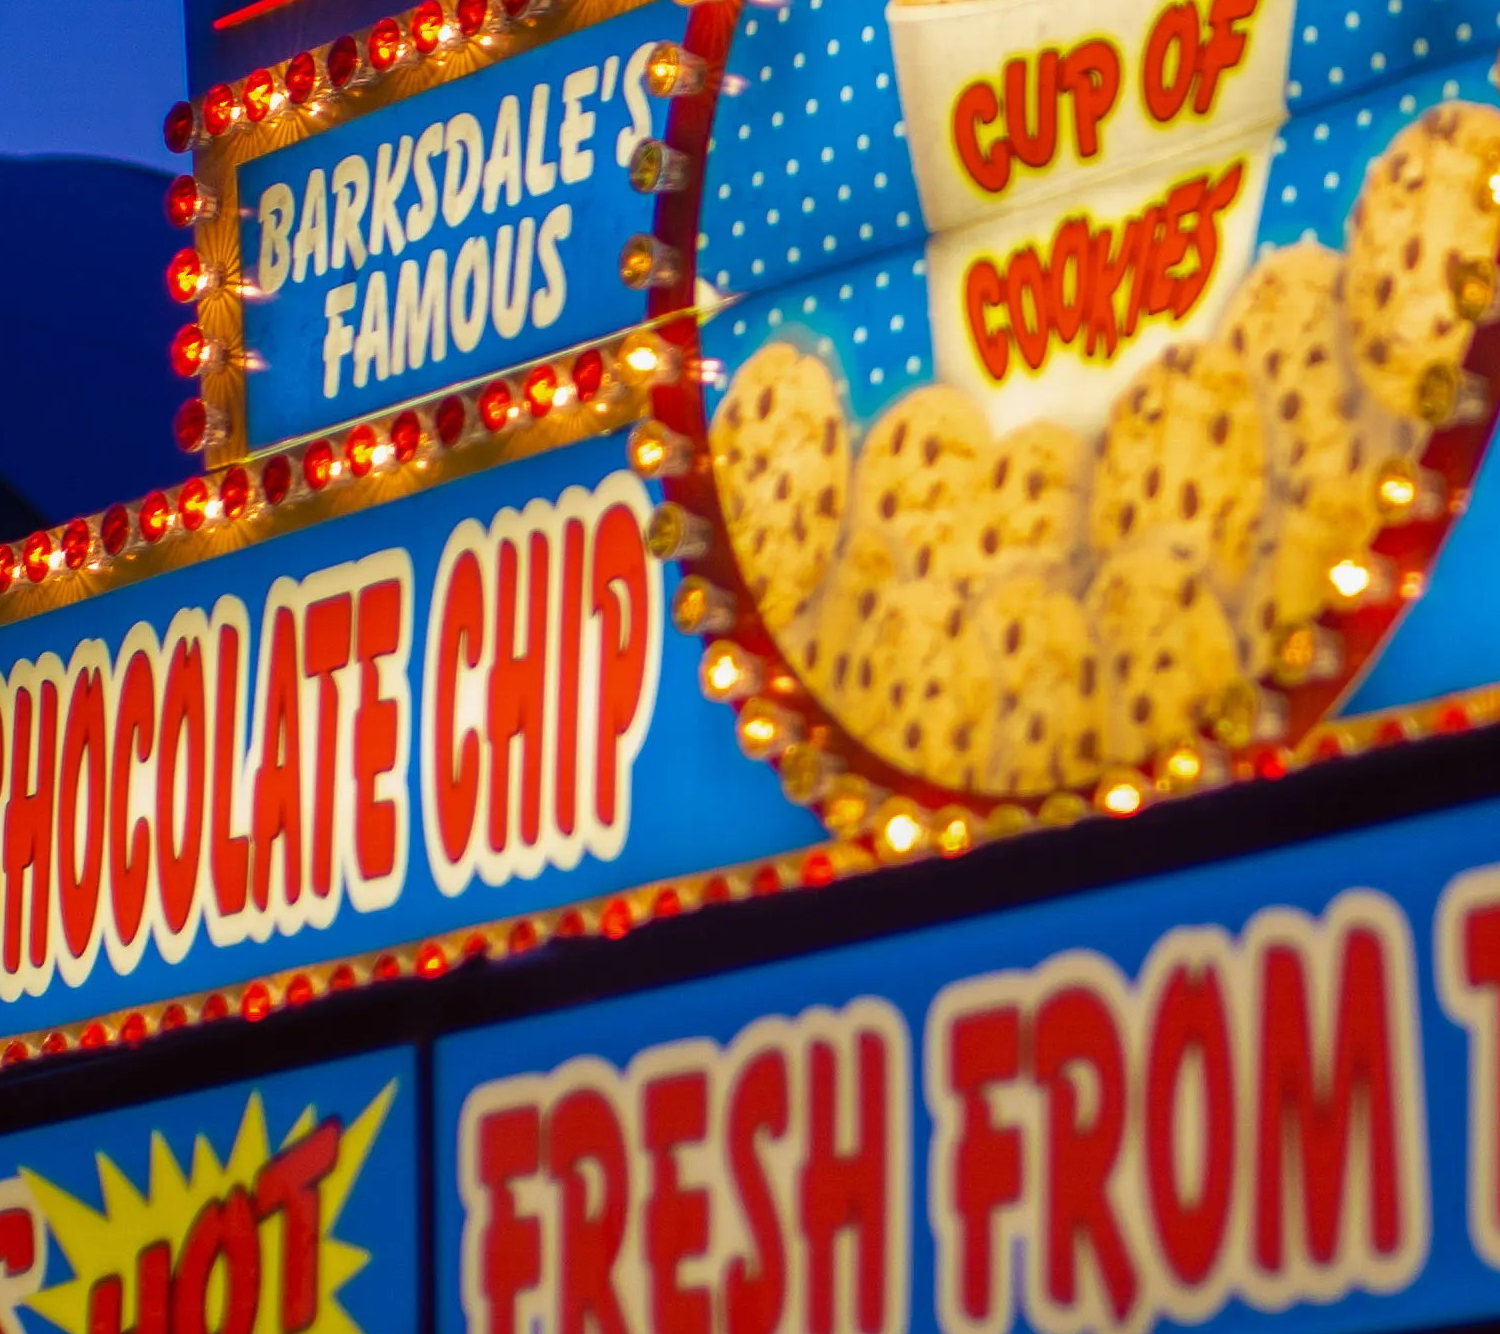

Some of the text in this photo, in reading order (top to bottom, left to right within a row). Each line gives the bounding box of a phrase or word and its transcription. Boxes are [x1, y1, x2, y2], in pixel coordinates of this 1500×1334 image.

[257, 40, 658, 296] BARKSDALE'S
[953, 37, 1120, 193] CUP
[321, 207, 572, 399] FAMOUS
[964, 159, 1245, 382] COOKIES
[421, 471, 664, 895] CHIP
